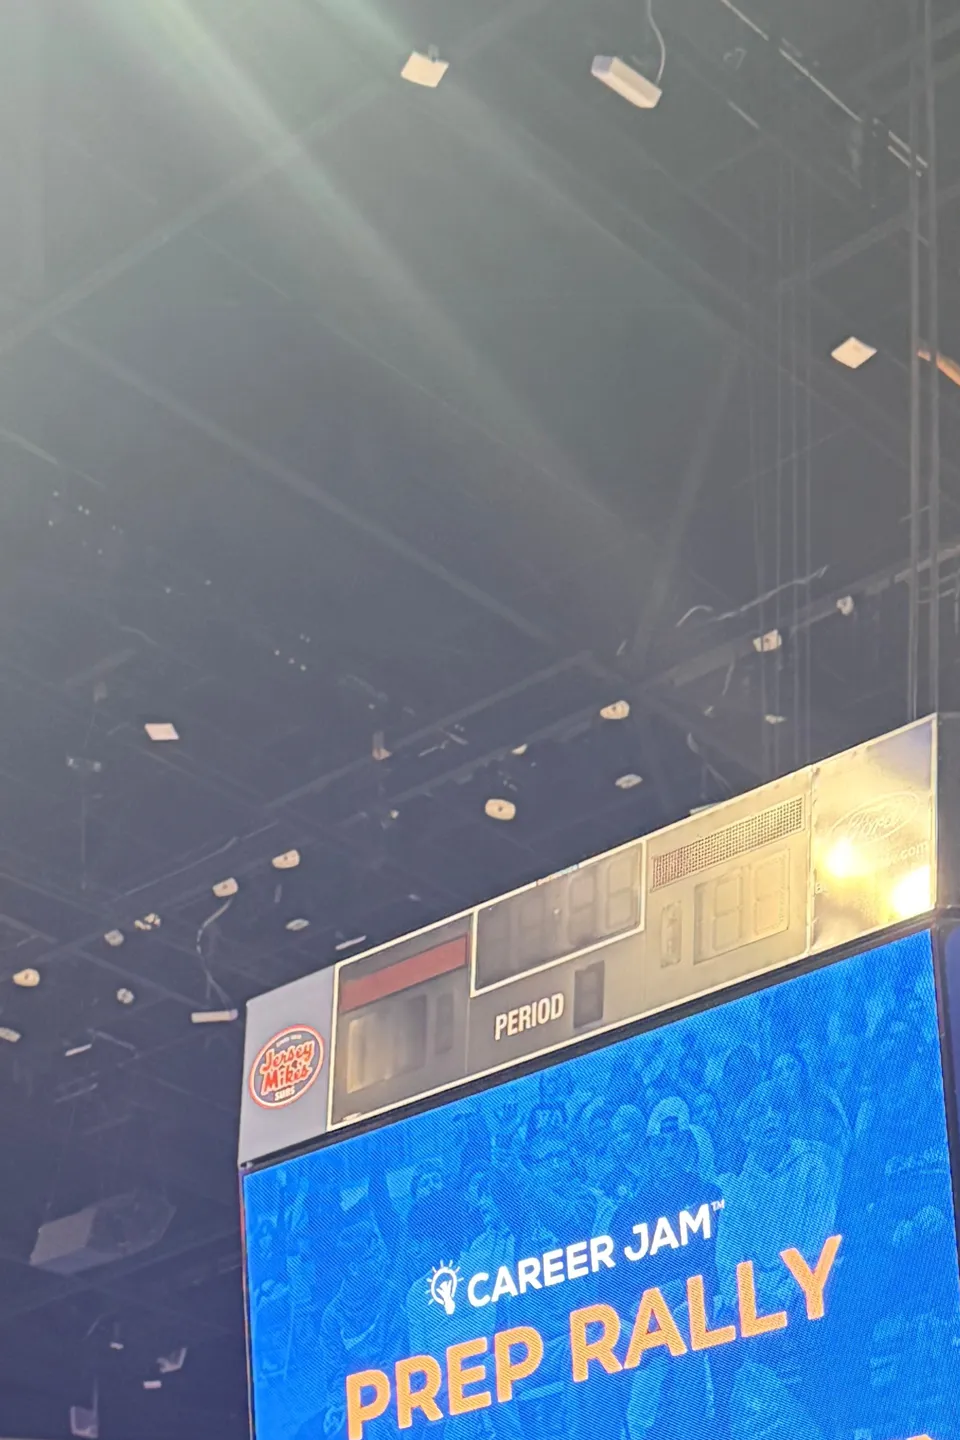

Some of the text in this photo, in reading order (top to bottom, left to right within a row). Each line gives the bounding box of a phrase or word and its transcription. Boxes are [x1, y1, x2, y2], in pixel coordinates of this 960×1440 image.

[494, 992, 565, 1041] PERIOD
[260, 1040, 316, 1075] Jersey
[467, 1235, 617, 1309] CAREER
[570, 1234, 843, 1383] RALLY
